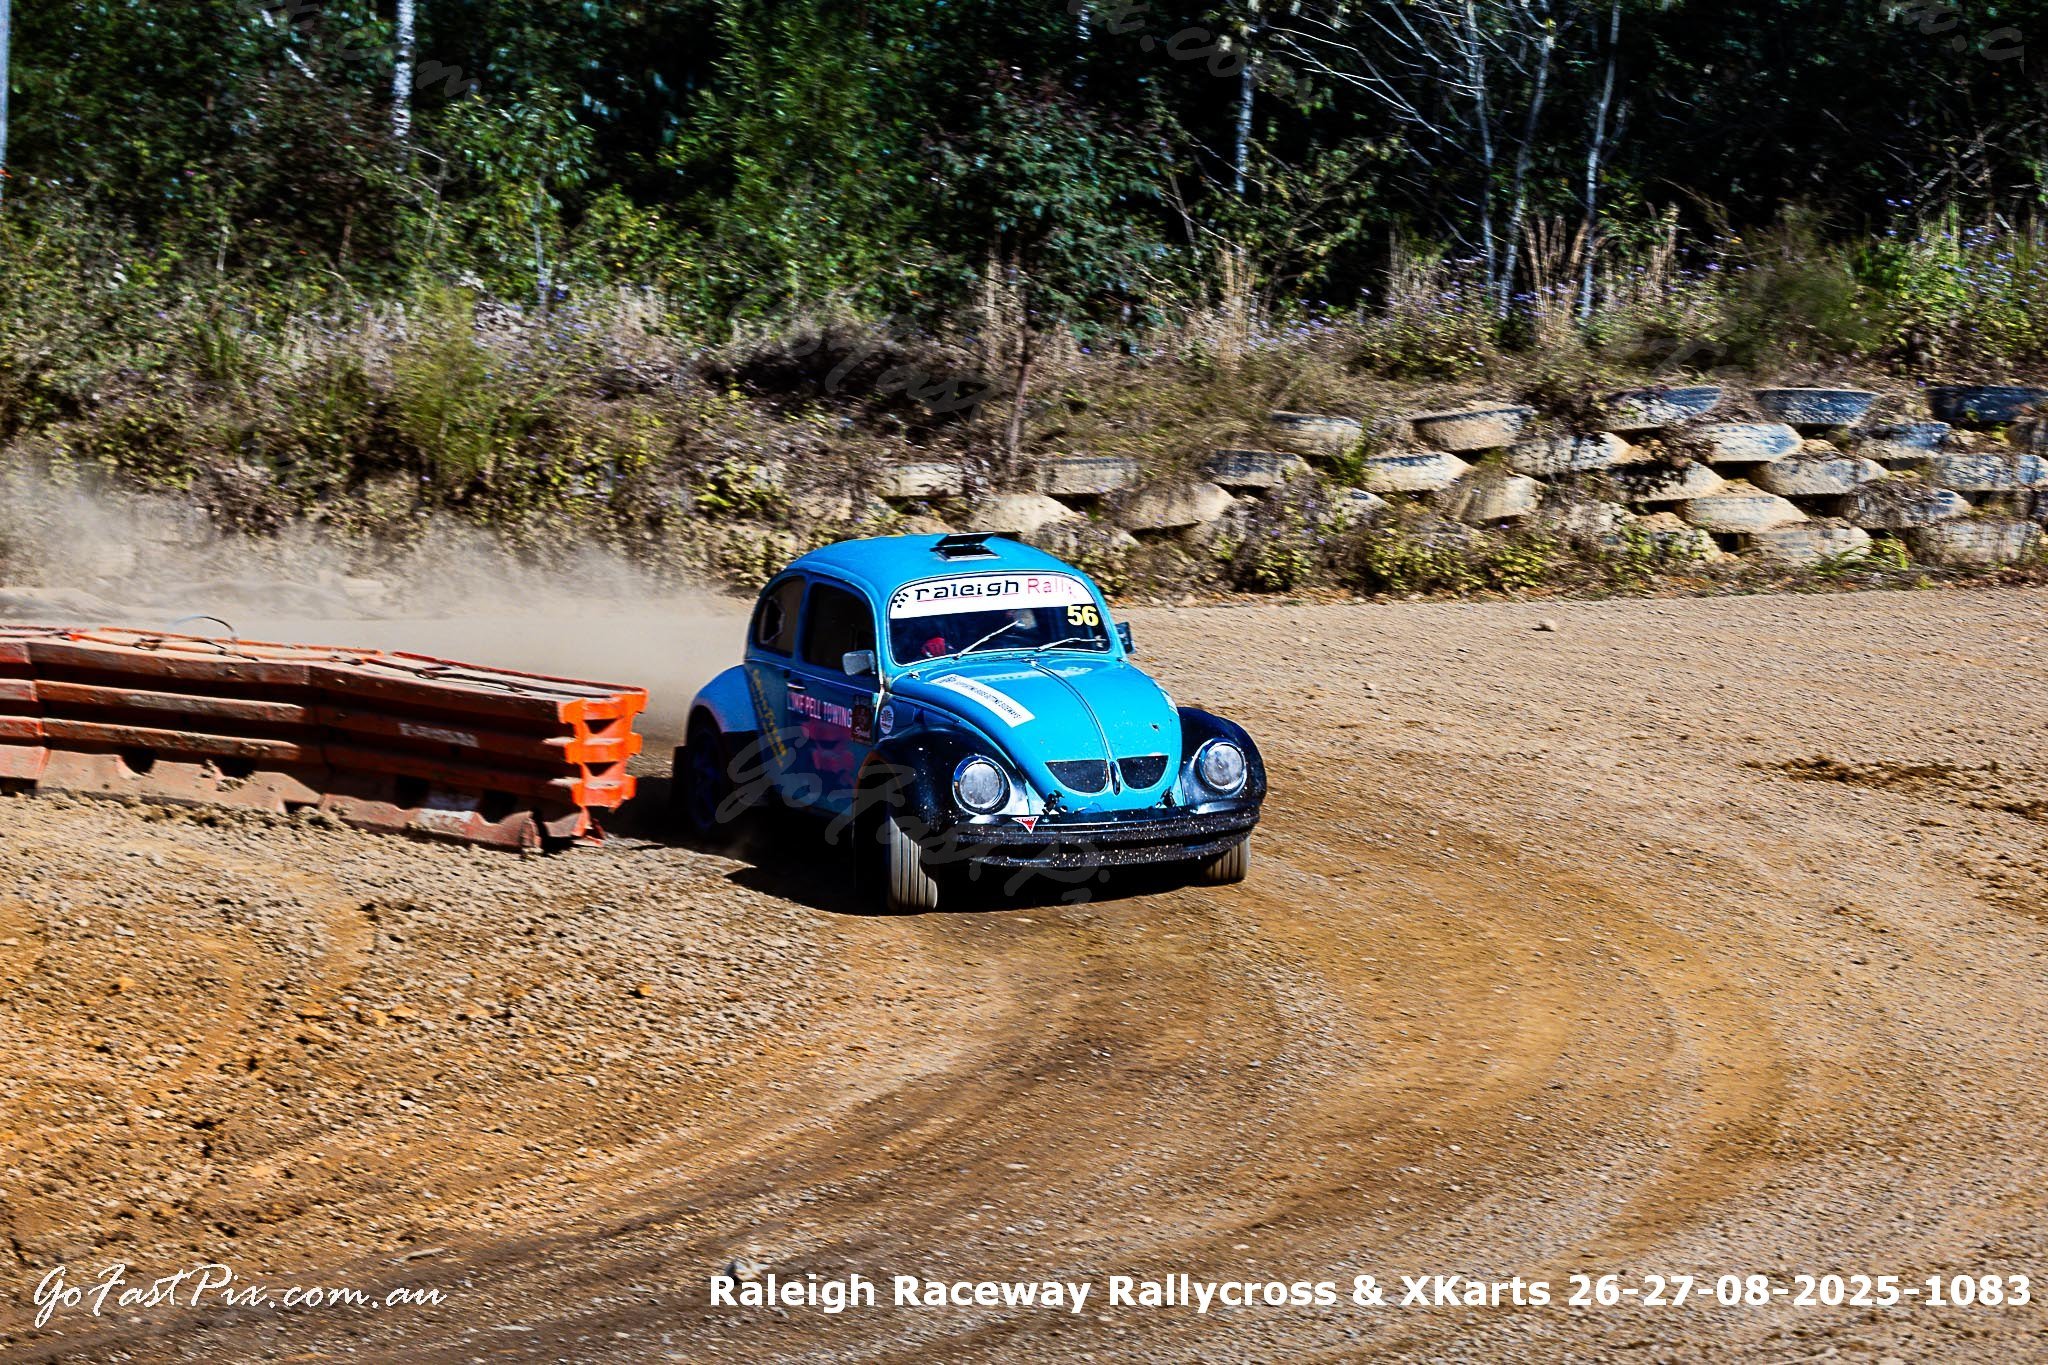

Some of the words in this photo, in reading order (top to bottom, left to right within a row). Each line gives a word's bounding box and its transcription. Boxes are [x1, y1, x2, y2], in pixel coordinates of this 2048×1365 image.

[914, 579, 1019, 601] raleigh
[1067, 604, 1100, 627] 56
[805, 696, 822, 720] PELL
[822, 701, 853, 729] TOWING
